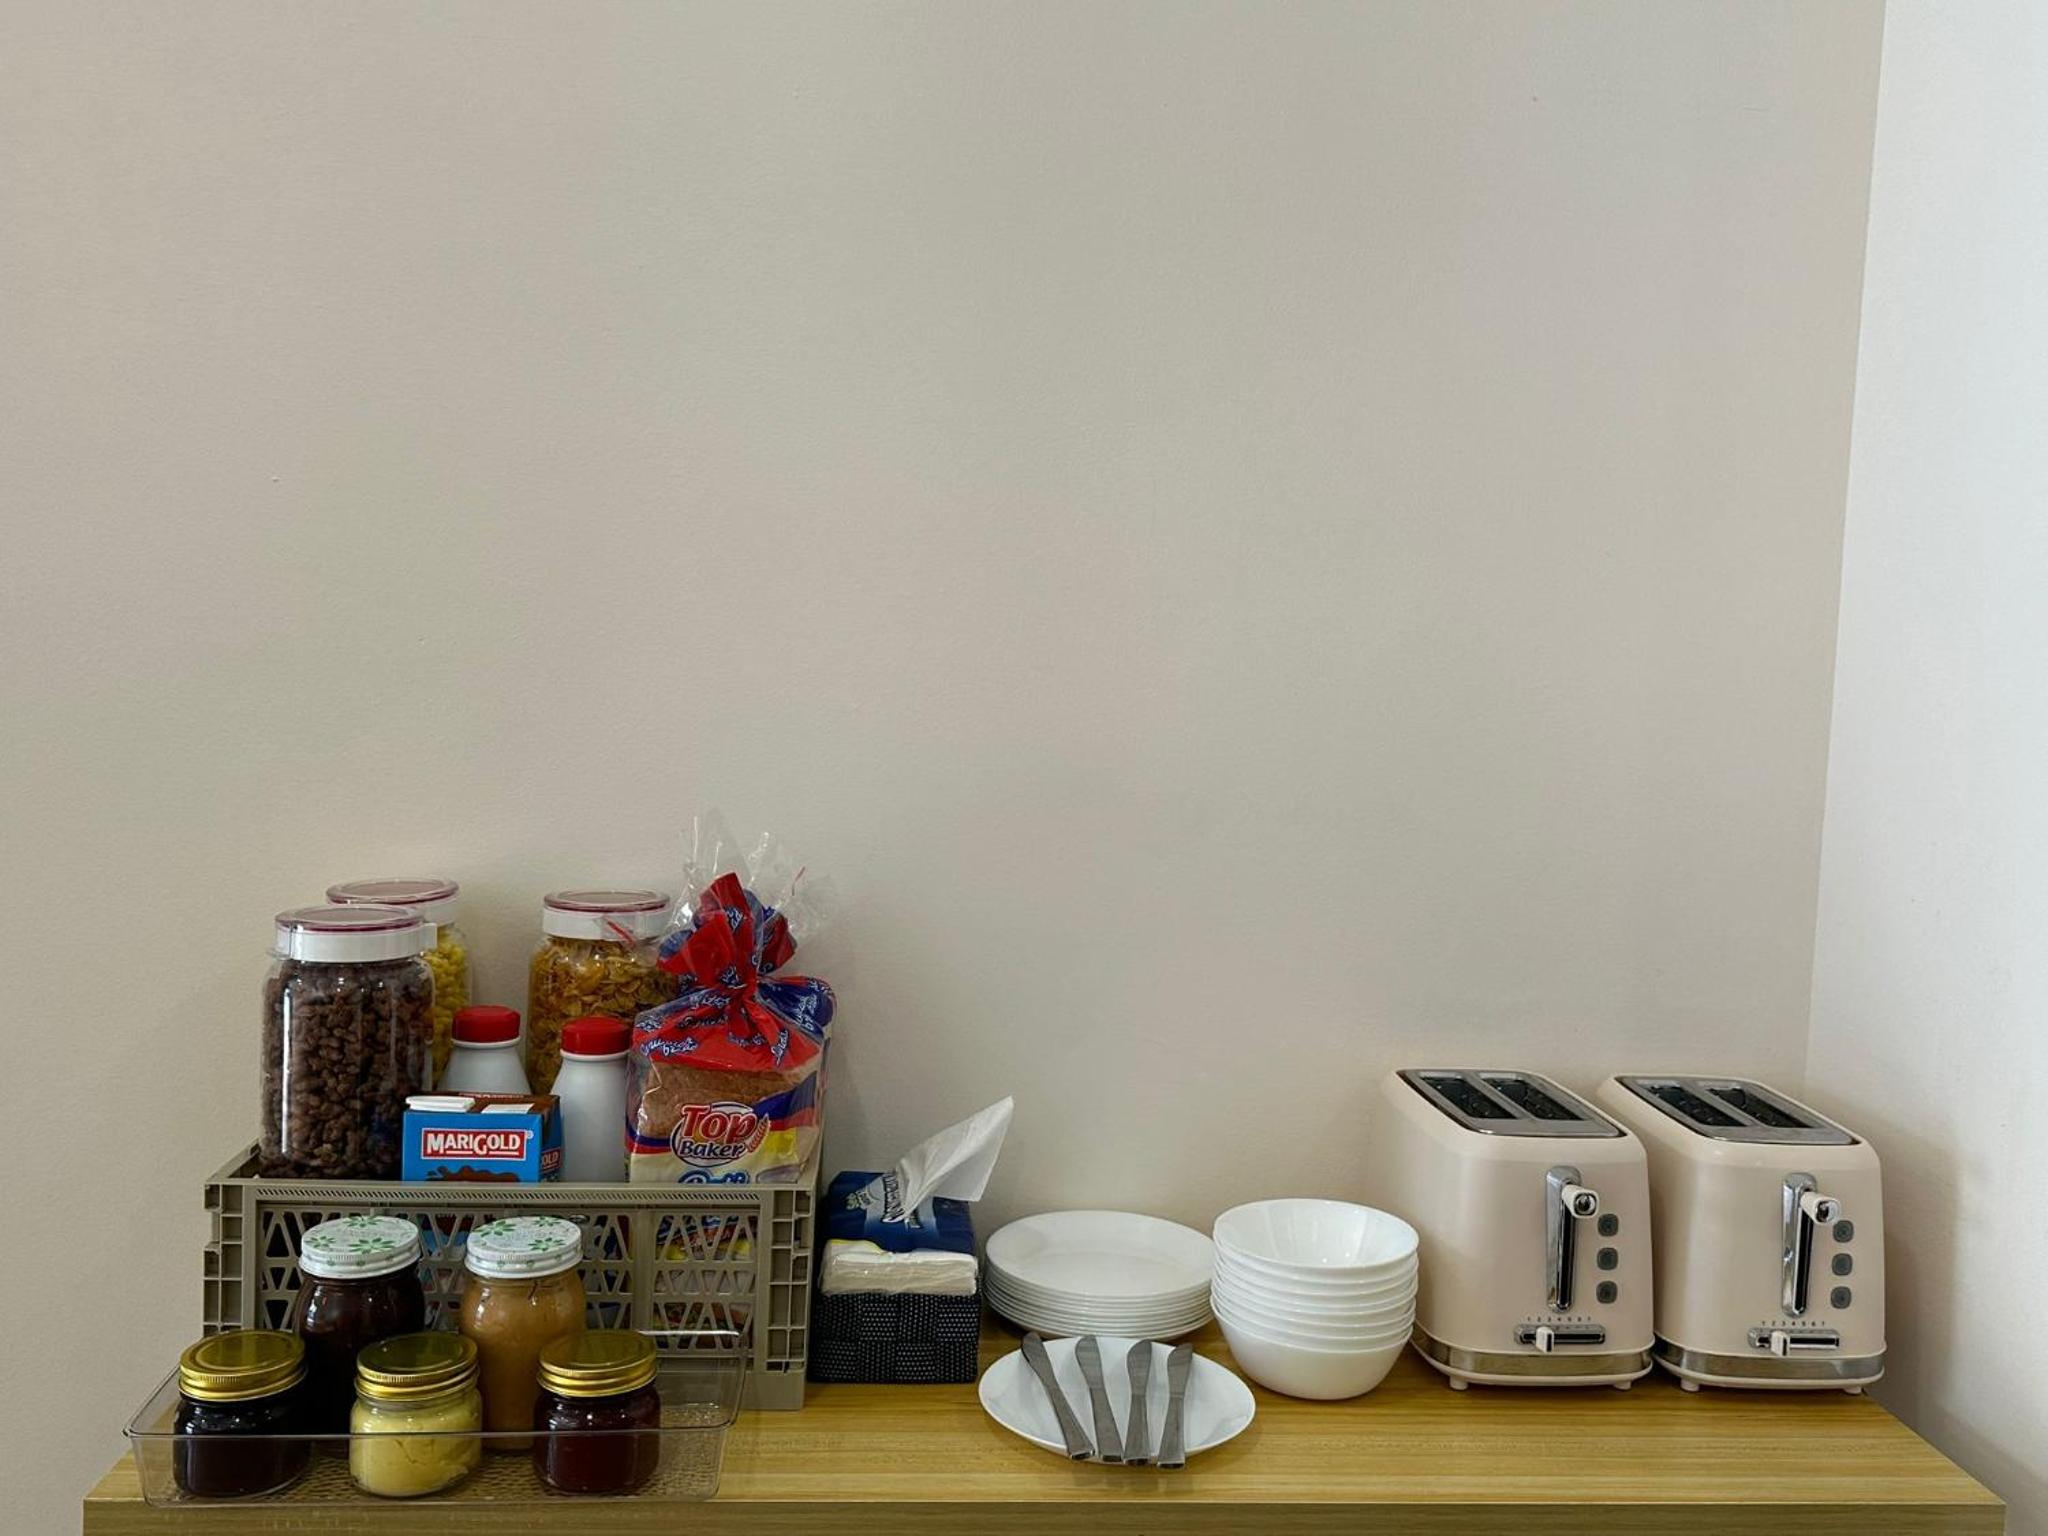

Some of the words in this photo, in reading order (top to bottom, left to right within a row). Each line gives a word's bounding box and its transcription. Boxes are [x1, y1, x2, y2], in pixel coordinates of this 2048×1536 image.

[681, 1105, 758, 1145] Top
[426, 1132, 521, 1155] MARIGOLD
[679, 1139, 746, 1159] Baker
[542, 1150, 559, 1166] OLD
